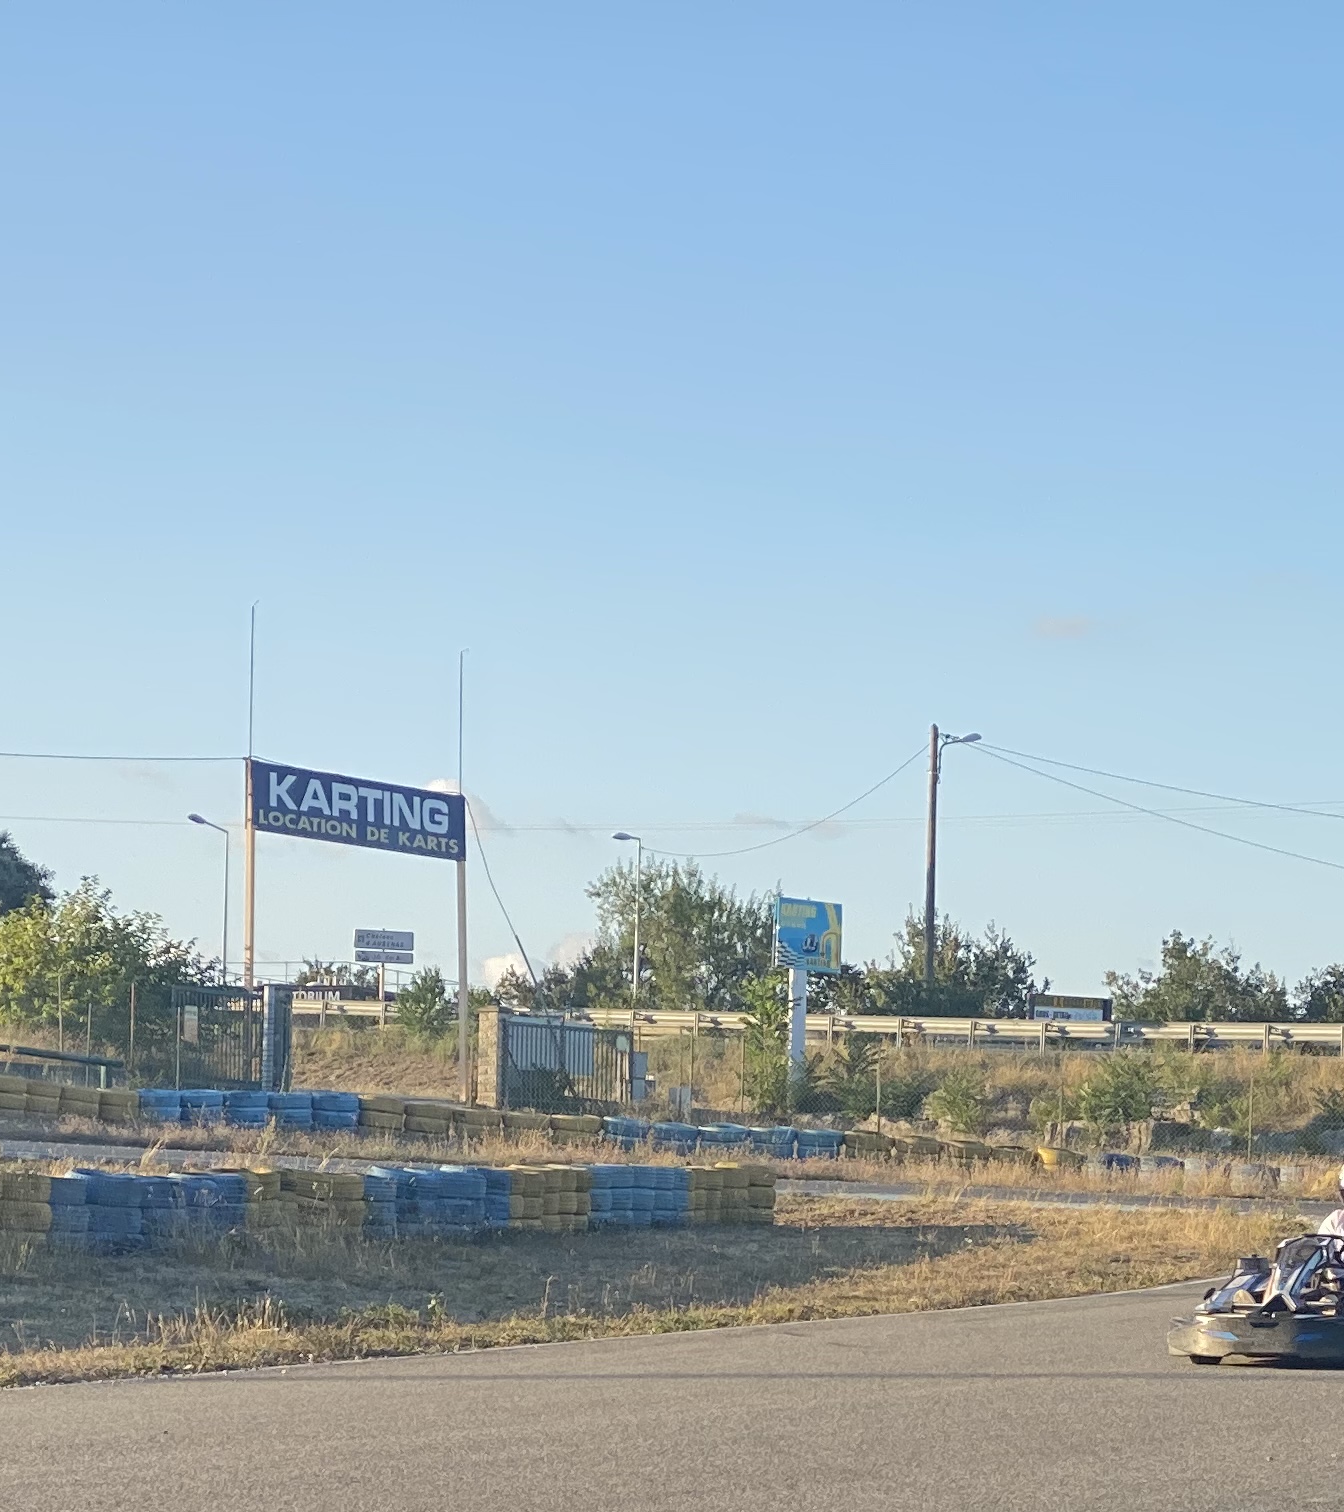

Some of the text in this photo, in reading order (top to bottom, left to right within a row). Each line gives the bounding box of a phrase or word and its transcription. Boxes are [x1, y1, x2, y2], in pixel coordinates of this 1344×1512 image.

[268, 771, 449, 835] KARTING
[258, 809, 459, 854] LOCATION DE KARTS
